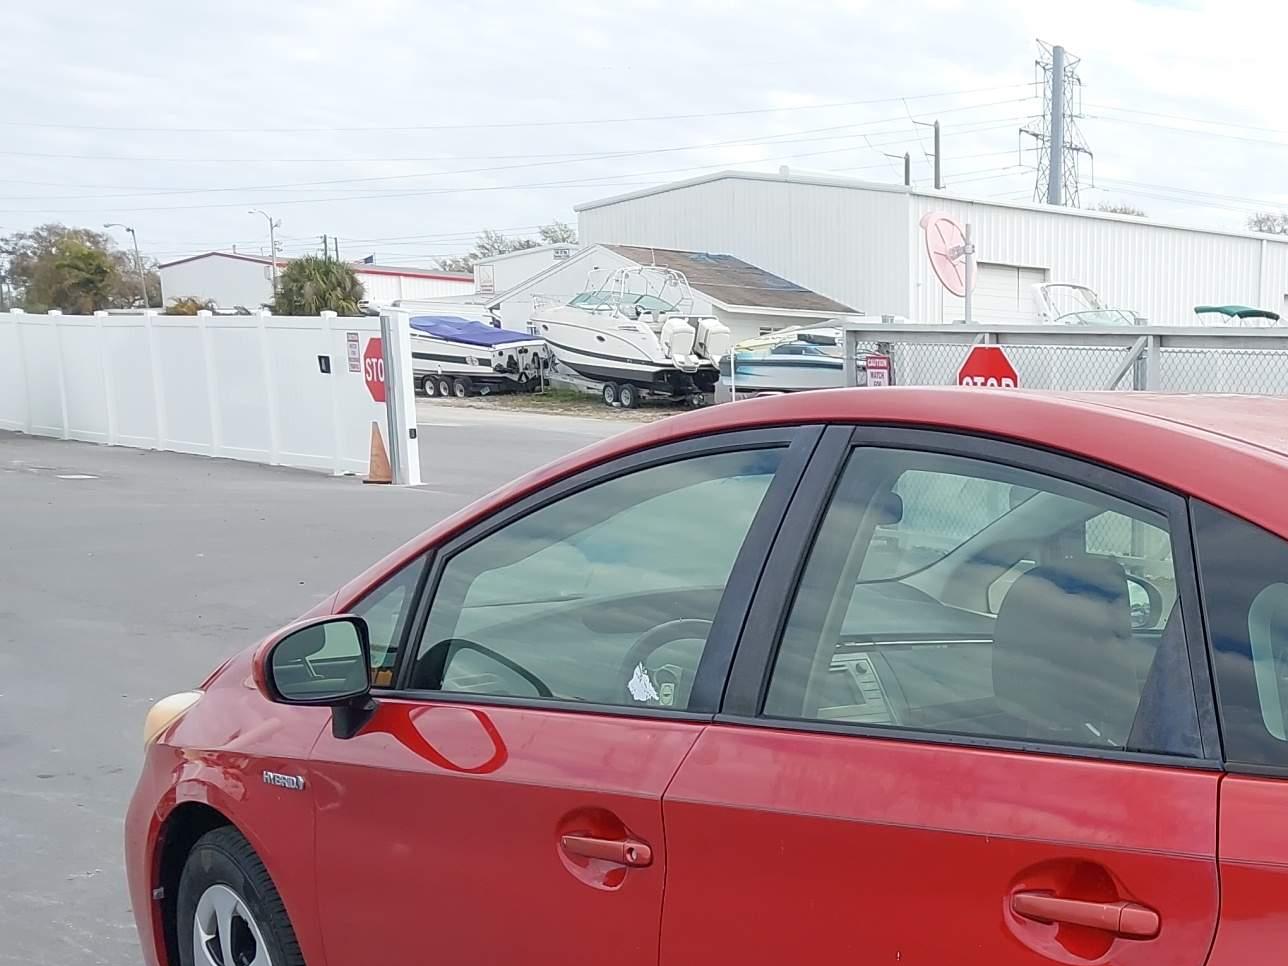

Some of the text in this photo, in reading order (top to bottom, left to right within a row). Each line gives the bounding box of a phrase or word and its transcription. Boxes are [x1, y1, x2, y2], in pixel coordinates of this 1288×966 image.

[868, 359, 887, 367] CAUTION
[366, 358, 384, 381] STO
[870, 370, 884, 378] WATCH
[263, 771, 296, 788] HYBRID
